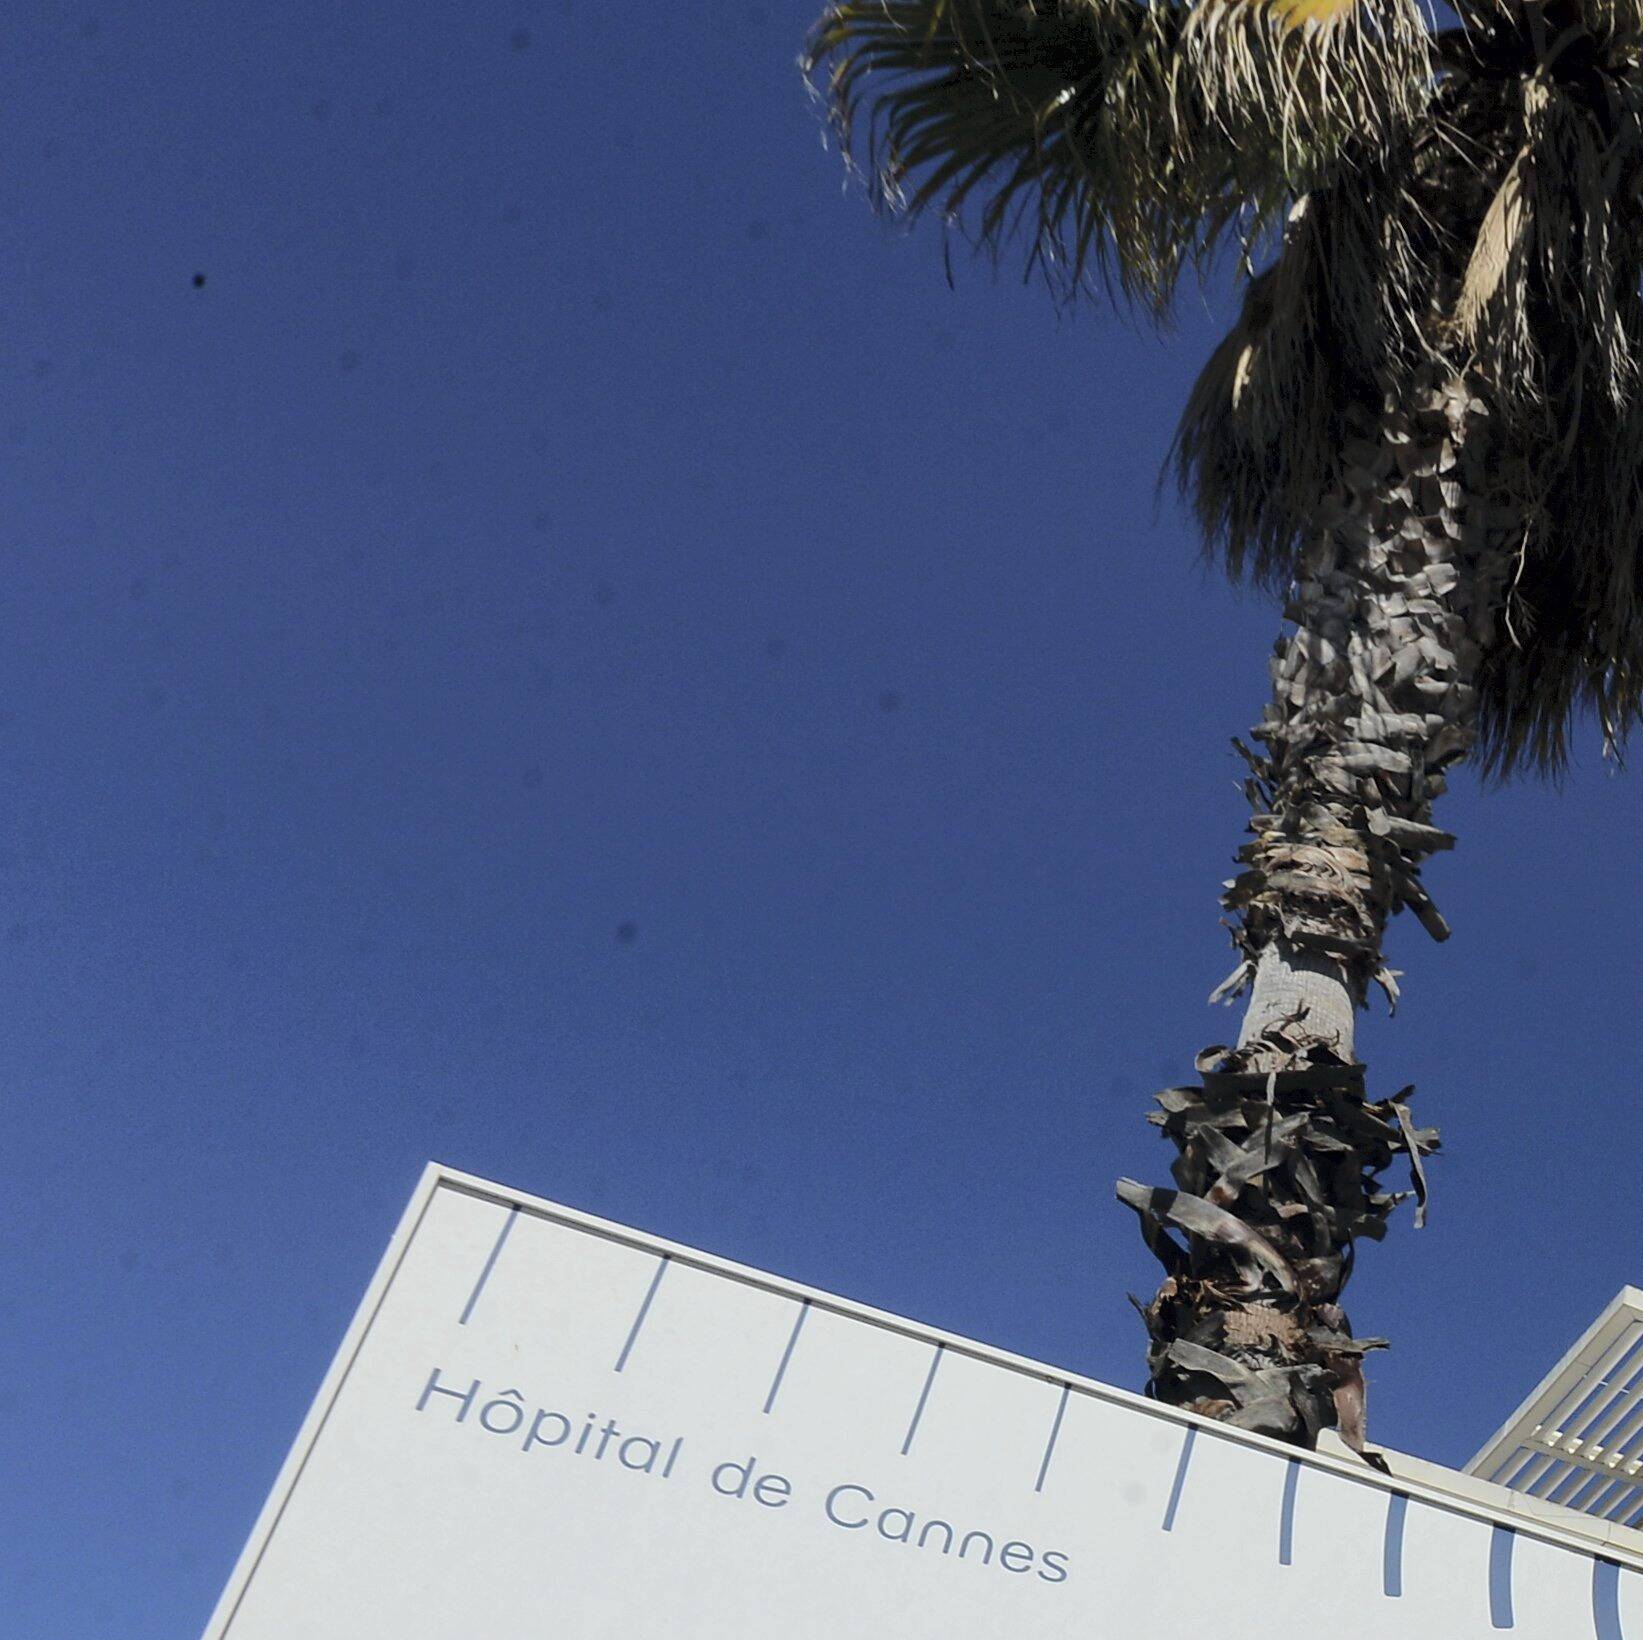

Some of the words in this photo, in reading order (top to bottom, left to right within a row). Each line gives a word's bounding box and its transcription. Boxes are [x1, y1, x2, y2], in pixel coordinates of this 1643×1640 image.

[414, 1367, 684, 1480] Hôpital
[711, 1455, 793, 1509] de
[823, 1483, 1071, 1584] Cannes
